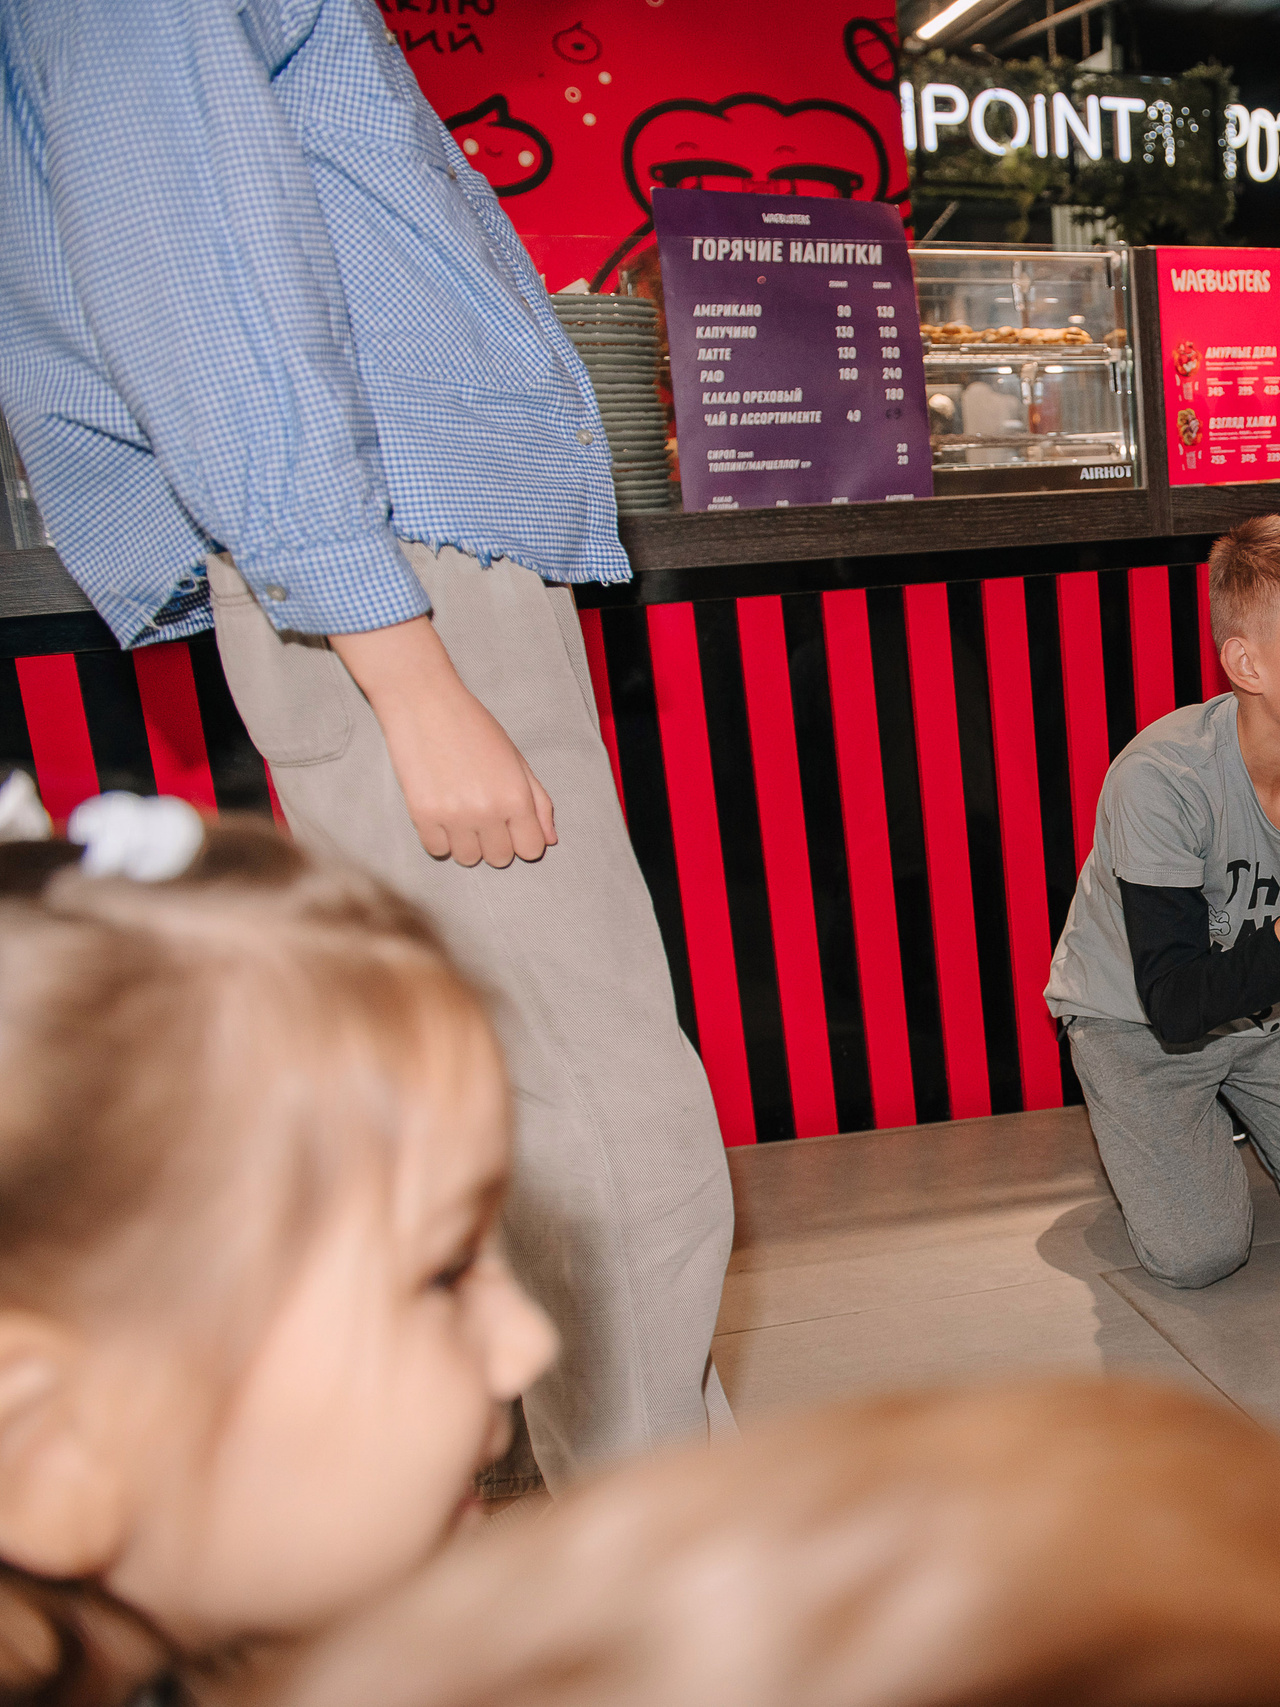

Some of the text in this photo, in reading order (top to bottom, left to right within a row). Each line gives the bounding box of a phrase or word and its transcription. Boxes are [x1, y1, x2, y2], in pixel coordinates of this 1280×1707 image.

[692, 238, 882, 266] ГОРЯЧИЕ НАПИТКИ
[1171, 268, 1271, 292] WAFBUSTERS
[693, 304, 762, 317] АМЕРИКАНО
[695, 325, 758, 339] КАПУЧИНО
[835, 325, 855, 339] 130
[697, 347, 732, 361] ЛАТТЕ
[837, 346, 857, 360] 130
[1205, 346, 1277, 359] АМУРНЫЕ ДЕЛА
[700, 369, 725, 383] РАФ
[882, 366, 903, 380] 240
[702, 390, 741, 404] КАКАО
[742, 387, 803, 404] ОРЕХОВЫЙ
[704, 411, 728, 426] ЧАЙ
[729, 412, 739, 426] В
[740, 410, 822, 426] АССОРТИМЕНТЕ
[846, 409, 862, 422] 49
[1208, 415, 1277, 429] ВЗГЛЯД ХАЛКА
[707, 449, 737, 460] СИРОП
[1080, 465, 1132, 481] AIRHOT
